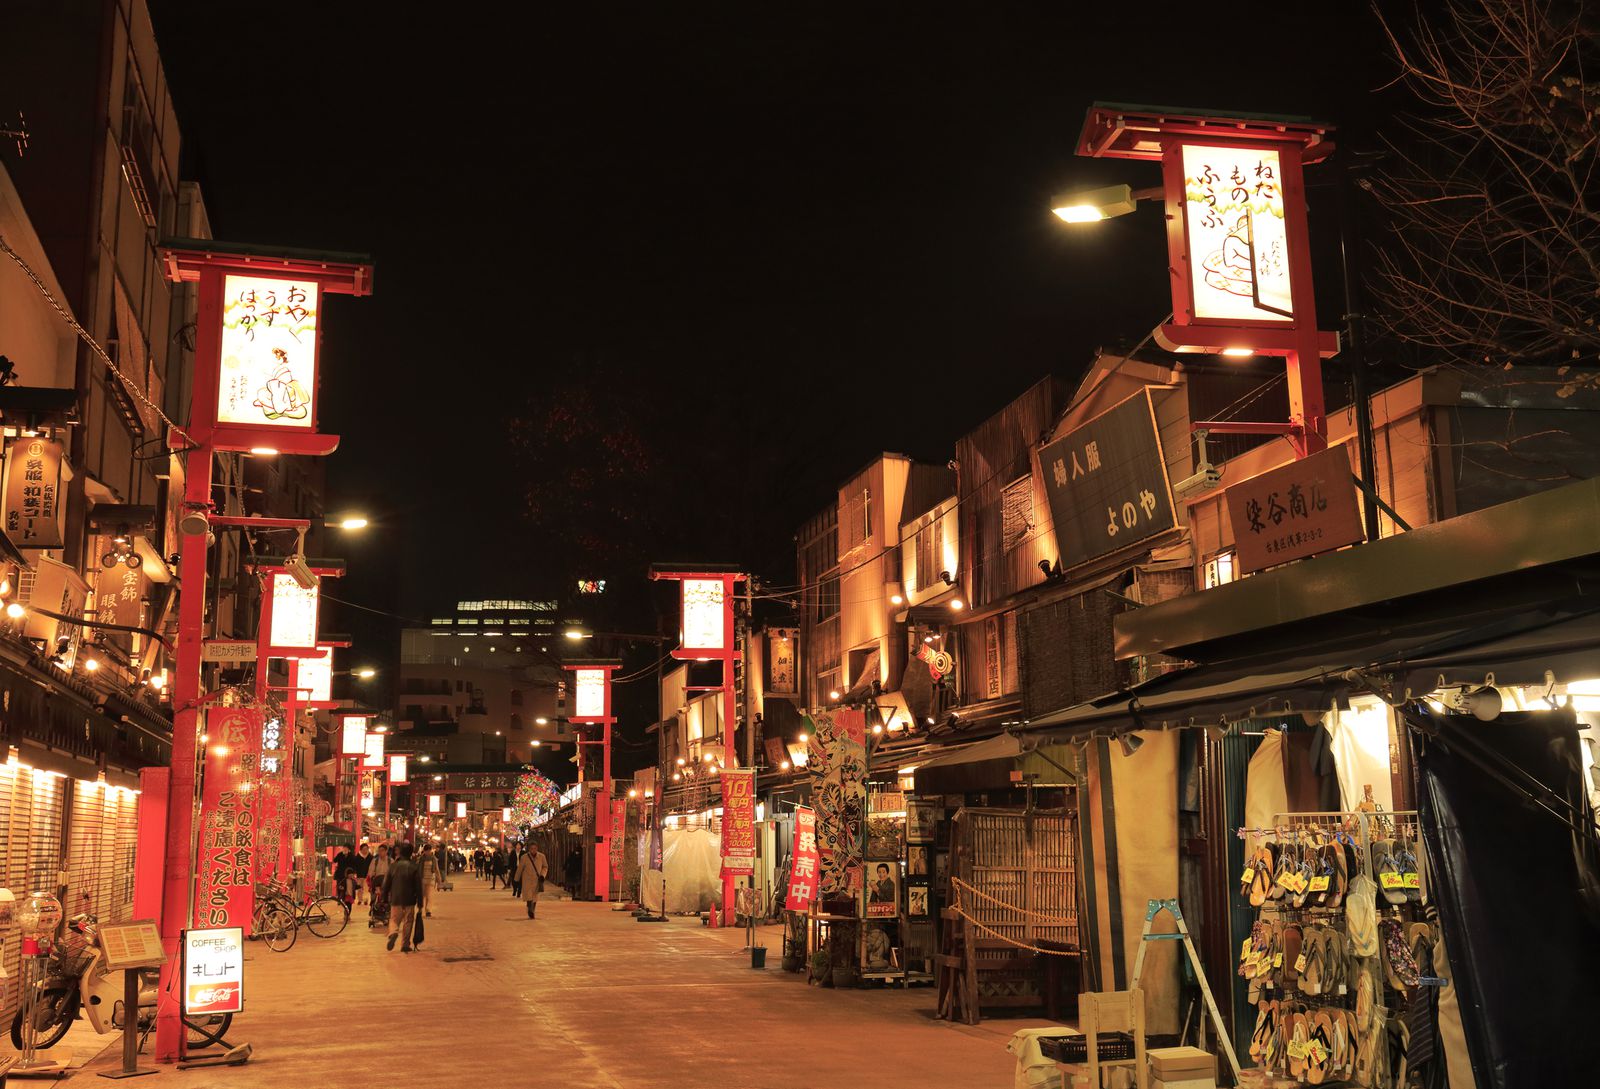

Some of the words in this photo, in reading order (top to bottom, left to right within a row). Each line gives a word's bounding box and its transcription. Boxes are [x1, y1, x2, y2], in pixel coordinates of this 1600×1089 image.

[1196, 165, 1223, 229] ふうふ
[1230, 165, 1249, 204] もの
[1254, 160, 1274, 199] ねた
[1053, 441, 1101, 488] 婦人服
[1108, 489, 1156, 534] よのや
[1246, 481, 1327, 534] 染谷商店
[120, 570, 138, 602] 宝飾
[99, 593, 117, 625] 眼鏡
[791, 831, 817, 903] 発売中
[192, 938, 226, 948] COFFEE
[214, 945, 237, 954] SHOP
